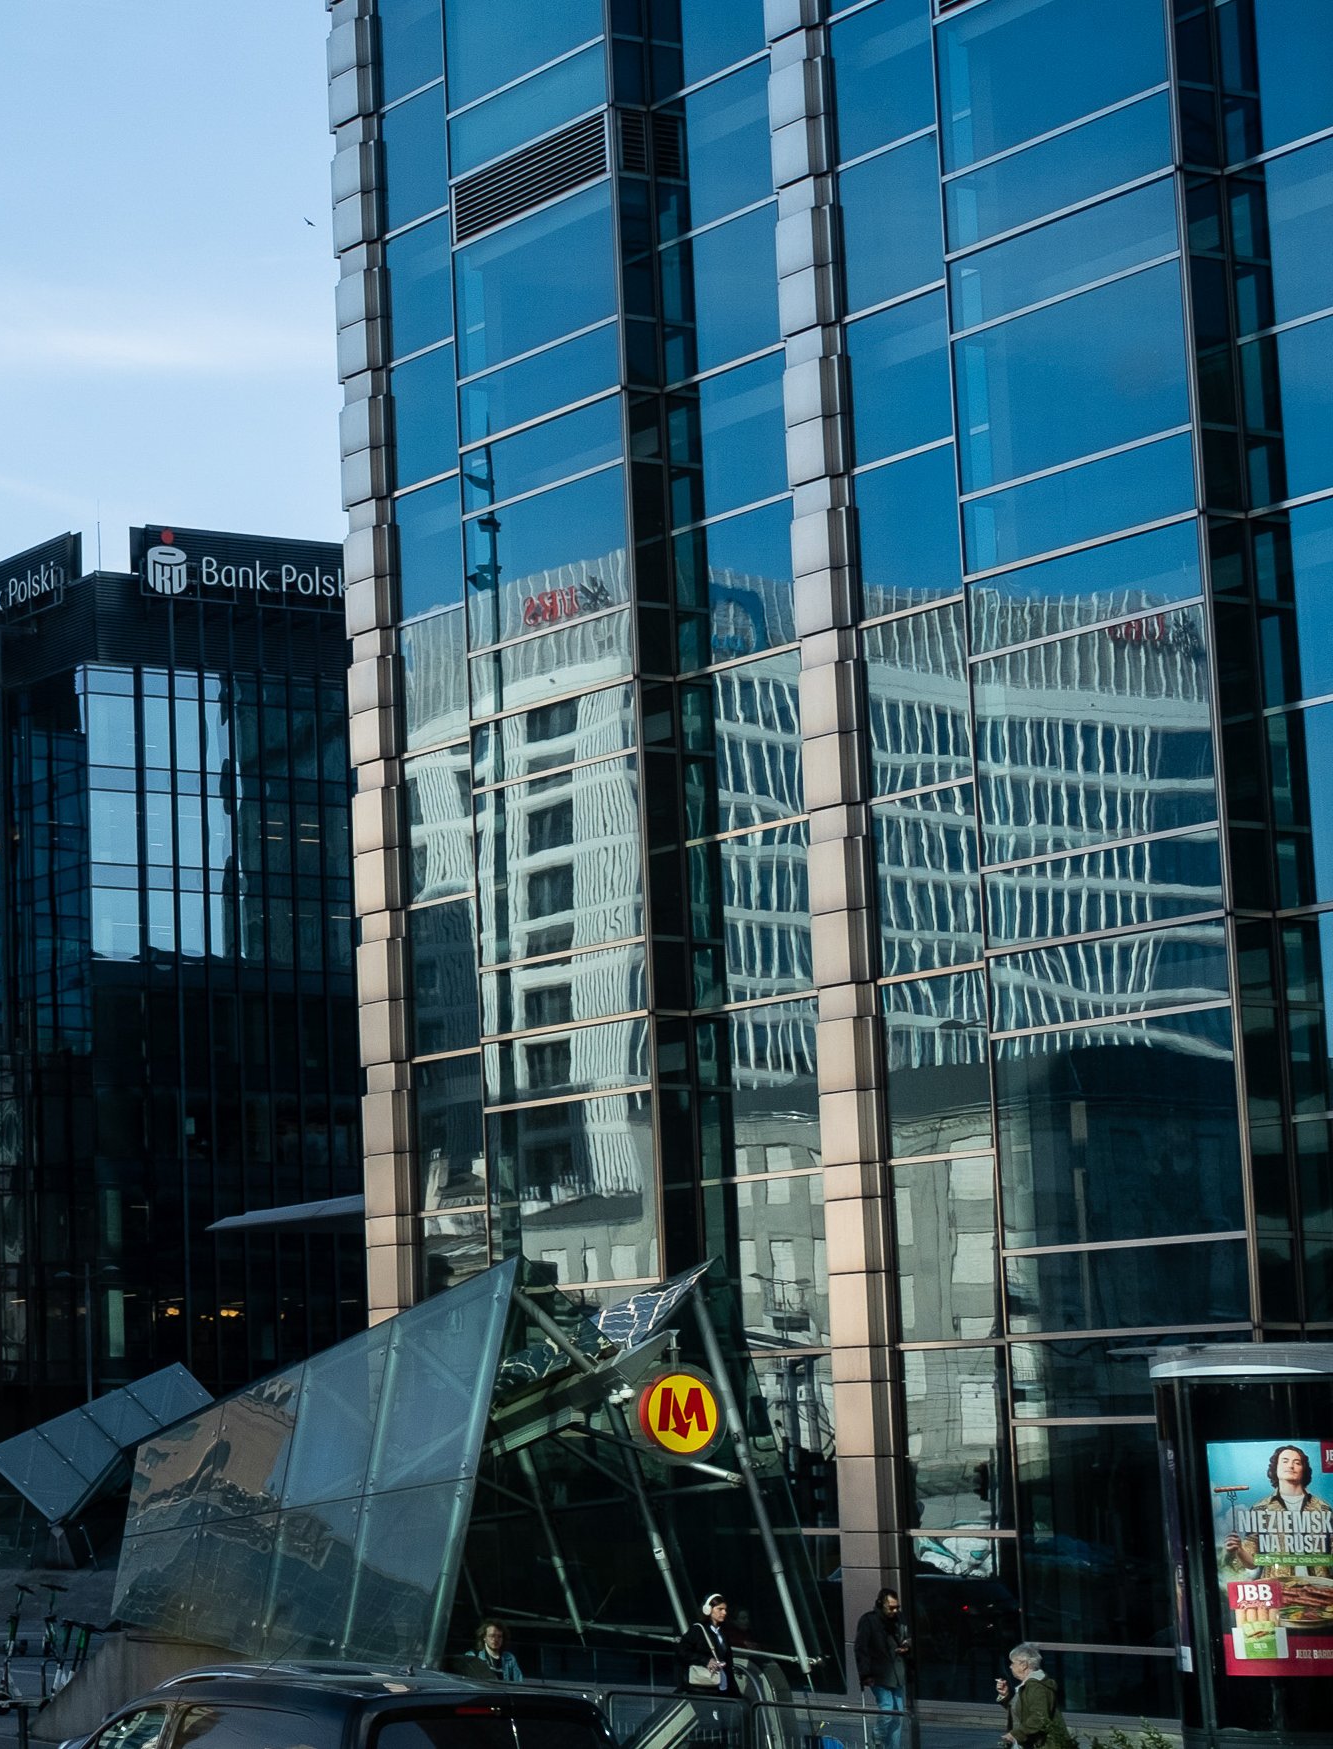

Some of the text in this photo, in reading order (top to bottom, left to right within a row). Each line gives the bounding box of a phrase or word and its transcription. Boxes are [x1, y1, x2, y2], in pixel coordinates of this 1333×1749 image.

[8, 560, 54, 606] Polski
[202, 556, 272, 591] Bank
[1258, 1534, 1327, 1553] NA RUSZT
[1237, 1584, 1273, 1603] JBB
